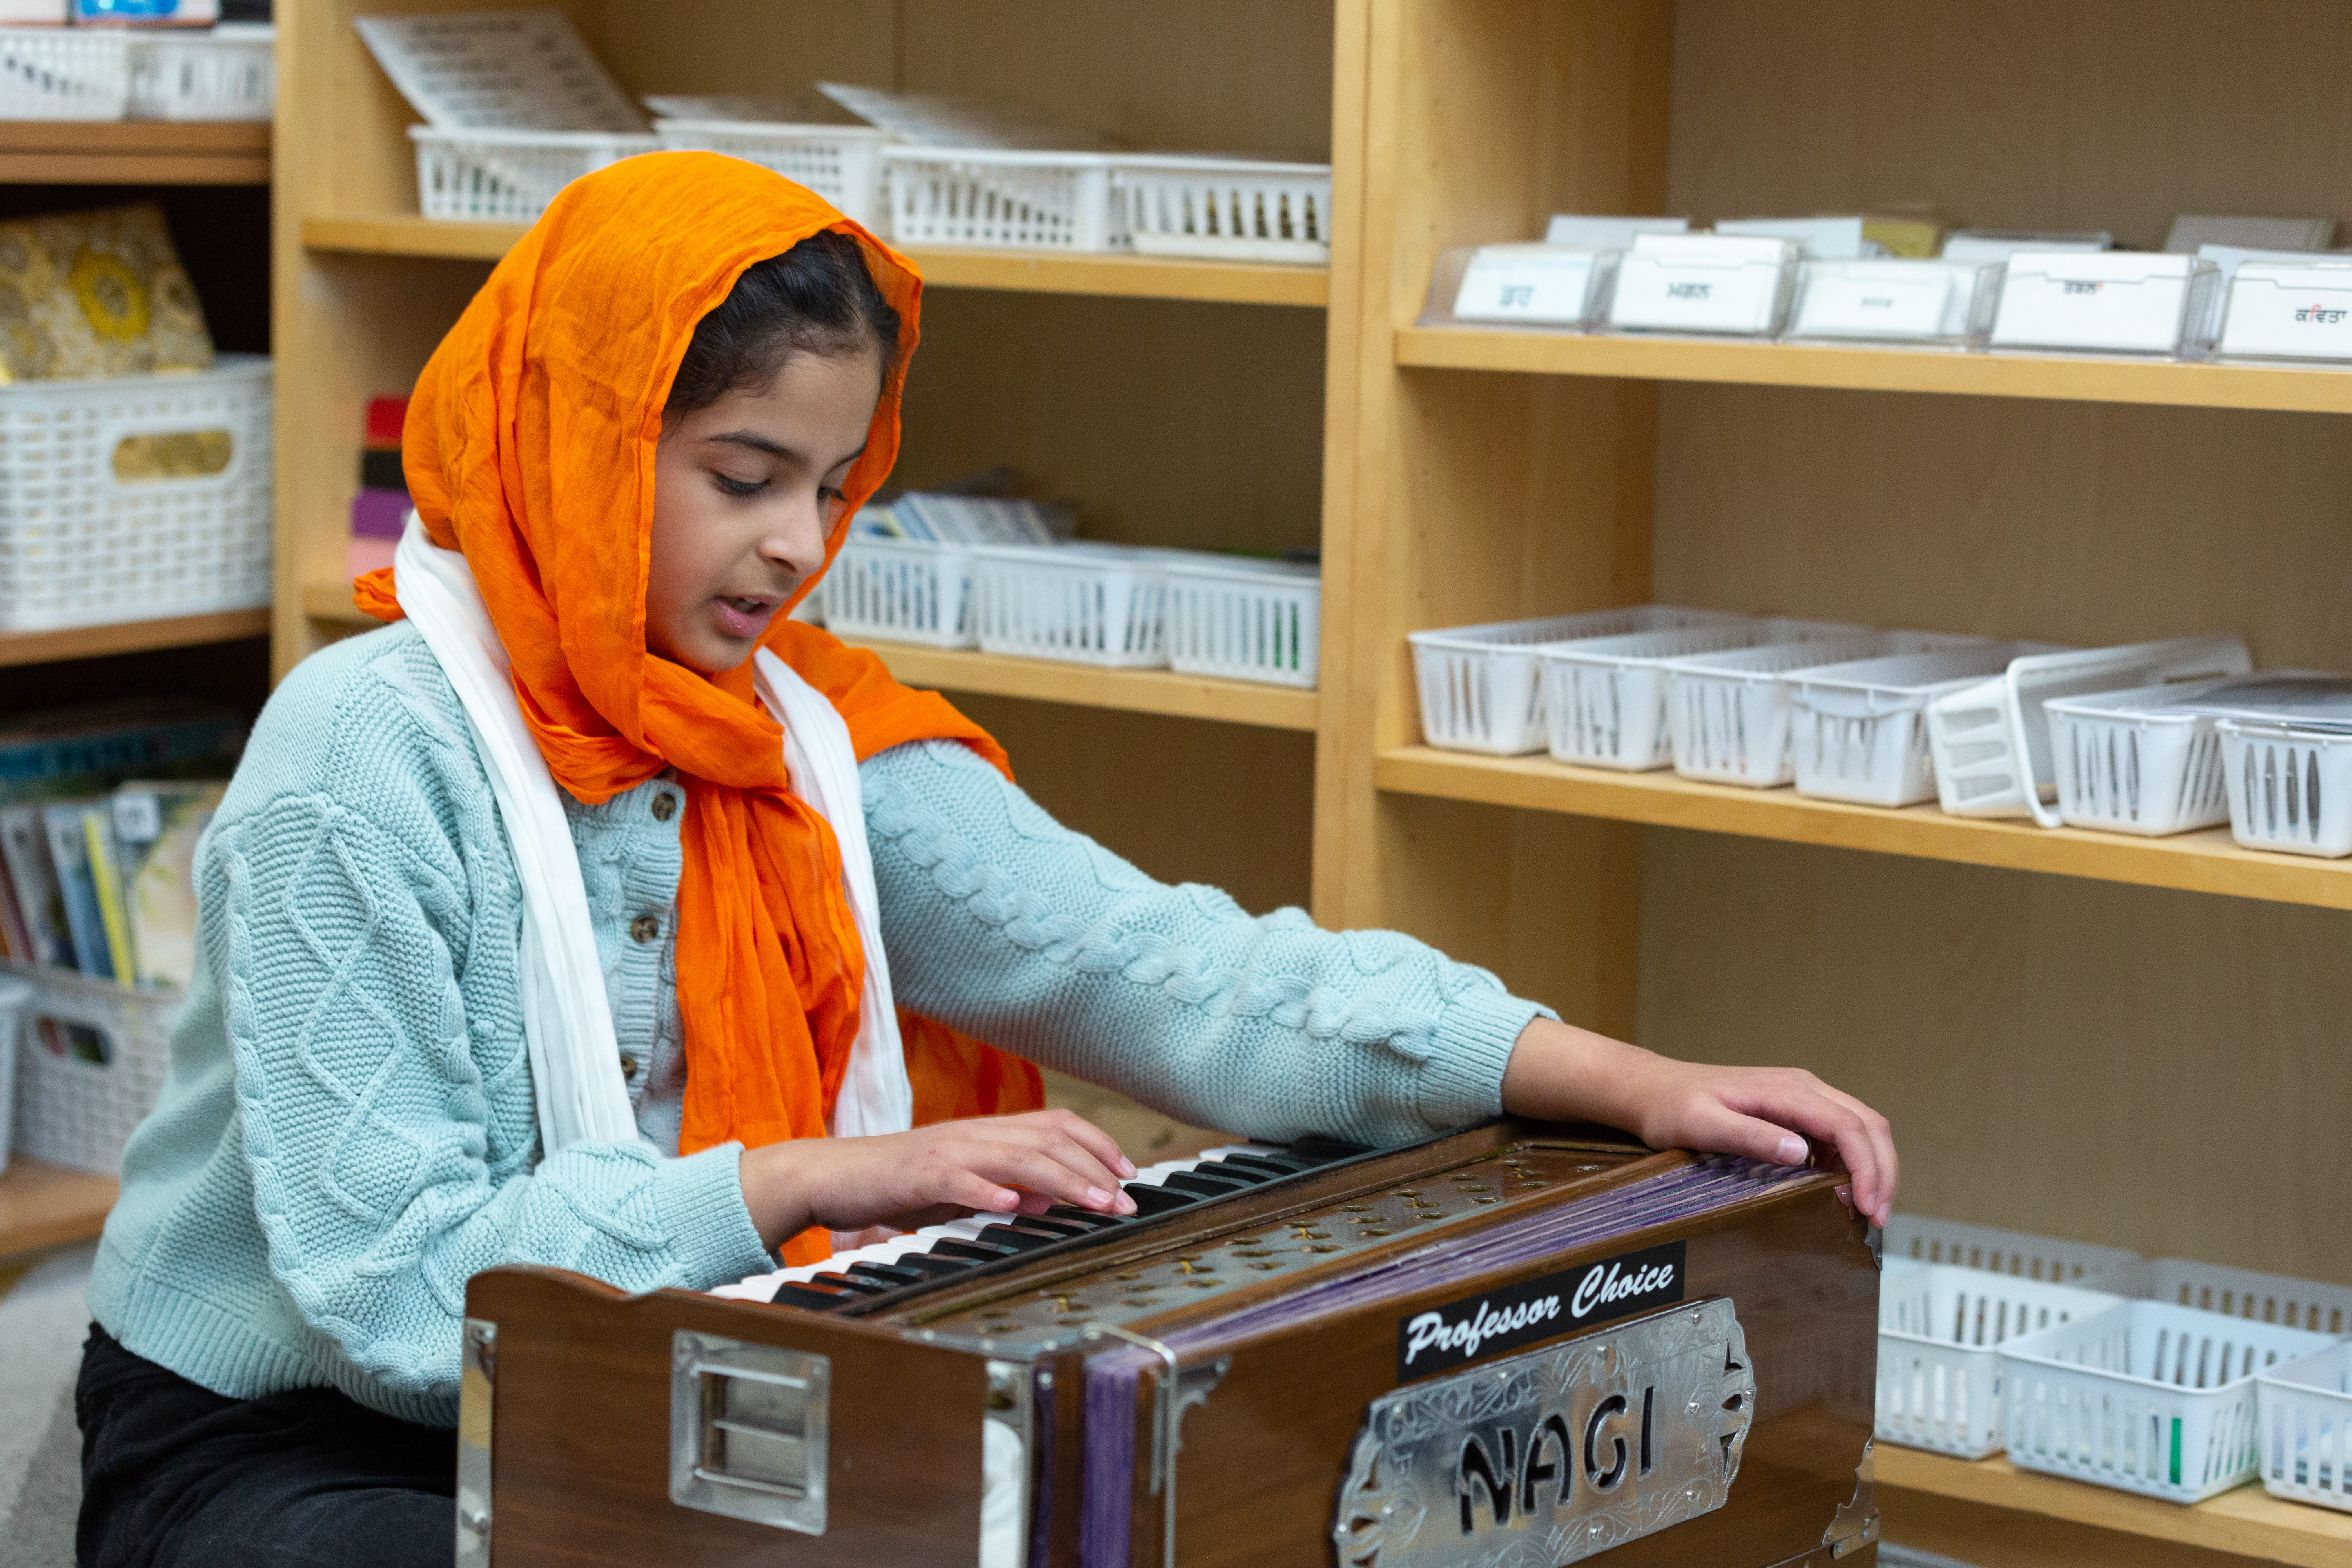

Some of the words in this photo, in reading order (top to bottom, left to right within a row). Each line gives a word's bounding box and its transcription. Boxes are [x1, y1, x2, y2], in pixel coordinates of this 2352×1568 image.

[2295, 304, 2348, 323] ਕਵਿਤਾ
[1405, 1295, 1561, 1365] Professor
[1571, 1262, 1674, 1319] Choice
[1460, 1385, 1655, 1535] NAGI
